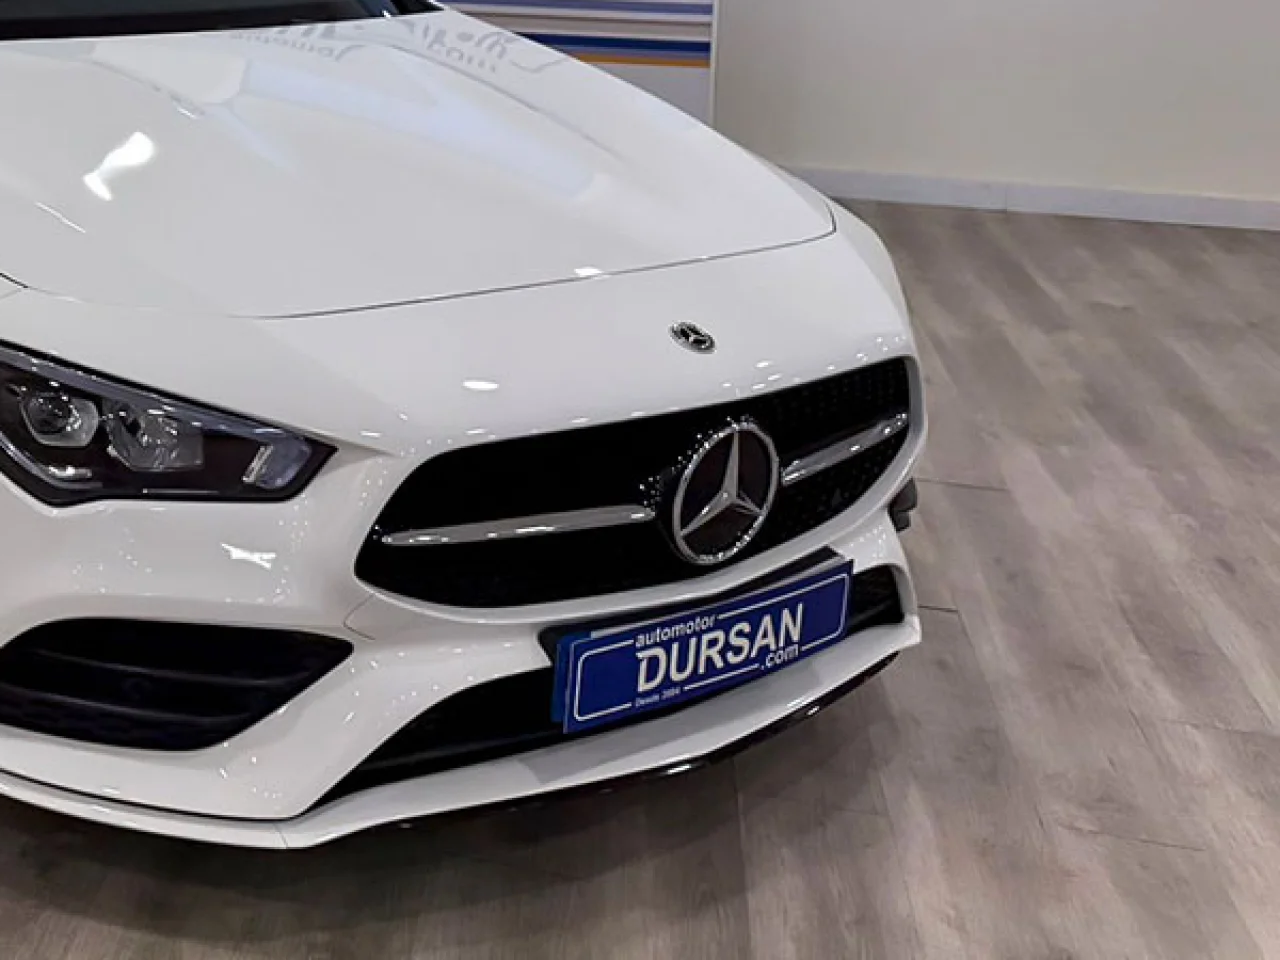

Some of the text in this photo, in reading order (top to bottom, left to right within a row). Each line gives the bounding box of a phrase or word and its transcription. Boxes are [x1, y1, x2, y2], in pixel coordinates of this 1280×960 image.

[635, 614, 716, 648] automotor
[635, 603, 803, 693] DURSAN
[760, 644, 799, 670] .com
